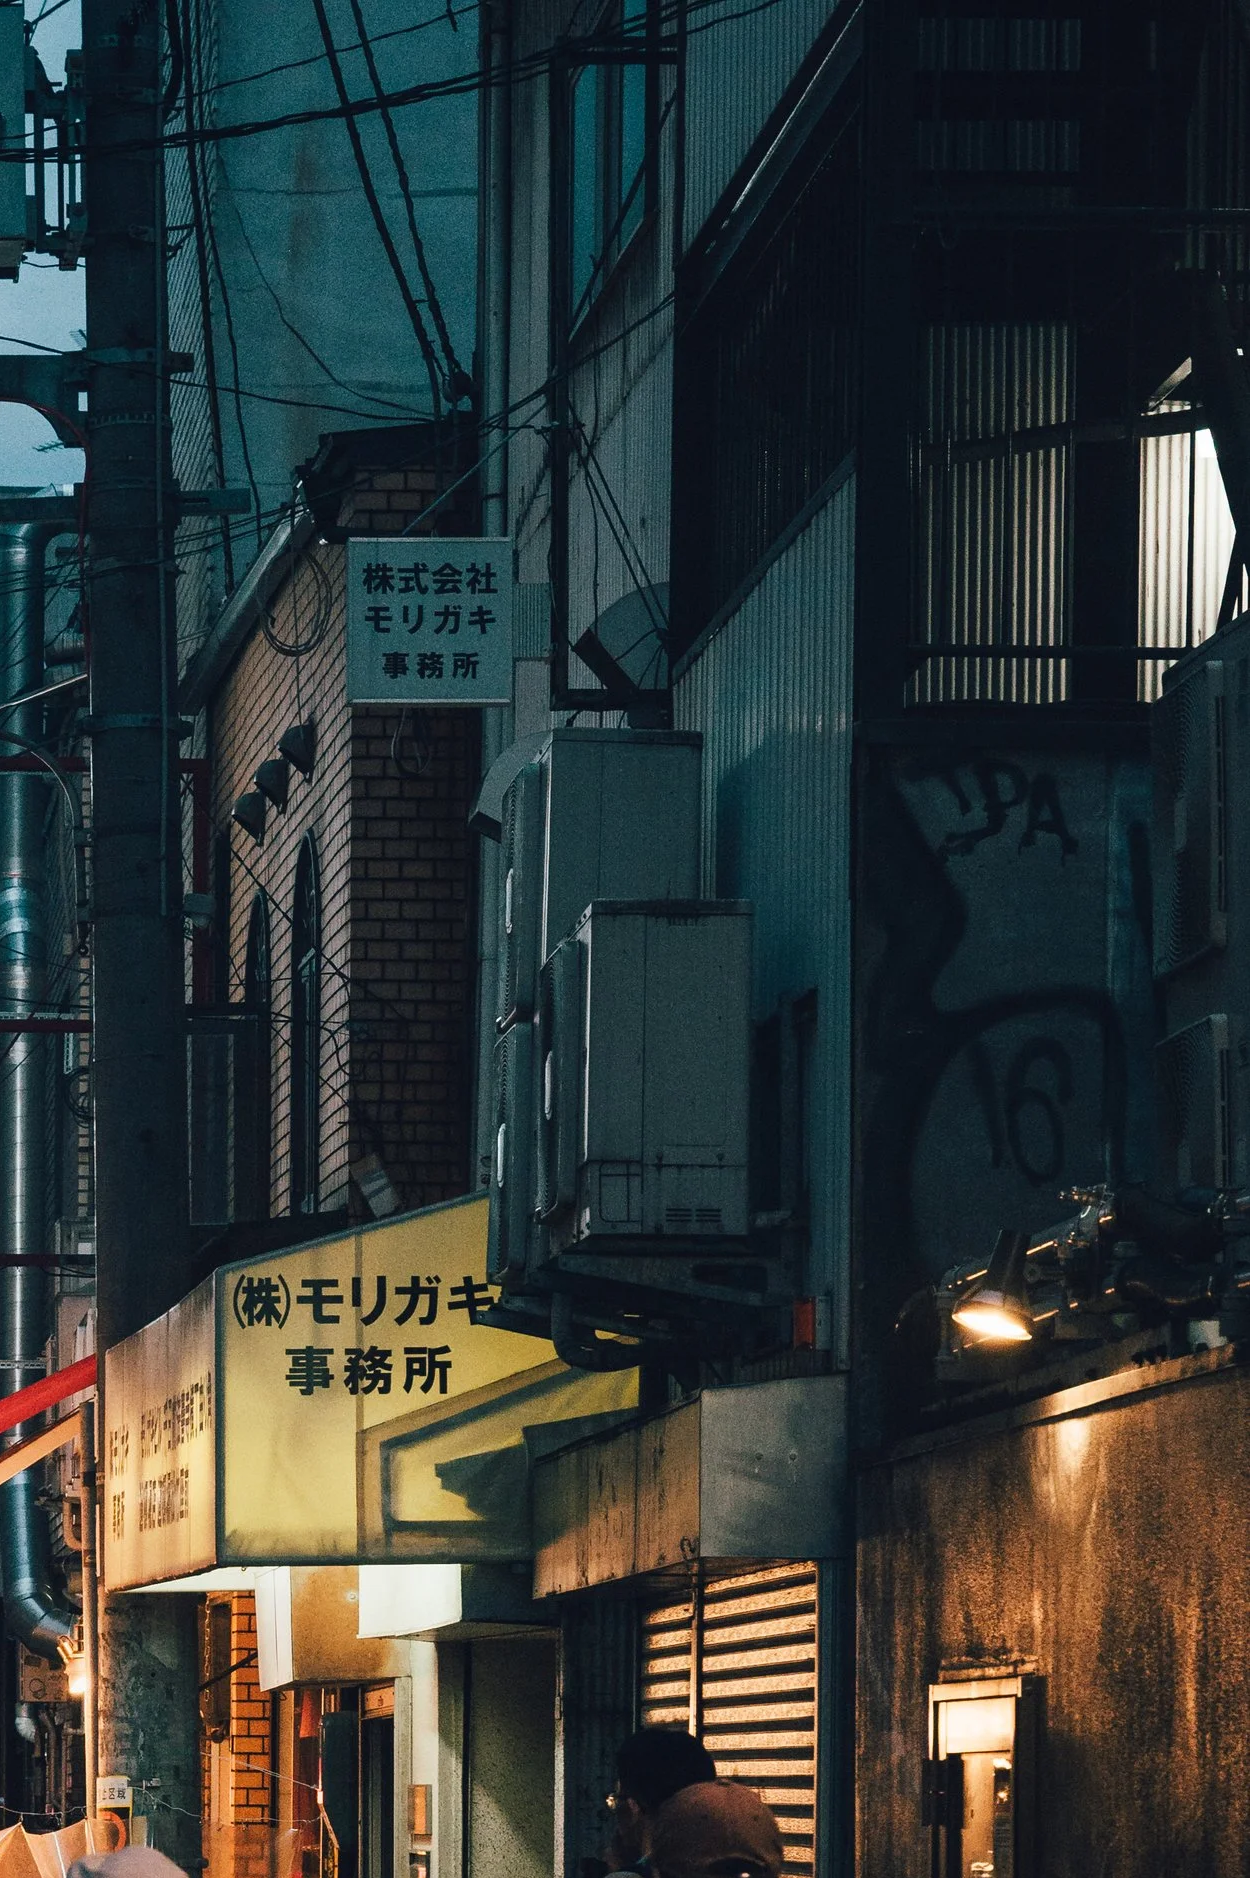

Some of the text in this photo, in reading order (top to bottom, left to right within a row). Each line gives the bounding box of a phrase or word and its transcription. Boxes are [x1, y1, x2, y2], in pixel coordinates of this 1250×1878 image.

[362, 562, 498, 595] 株式会社
[364, 604, 497, 635] モリガキ
[382, 652, 480, 680] 事務所
[285, 1345, 453, 1397] 事務所
